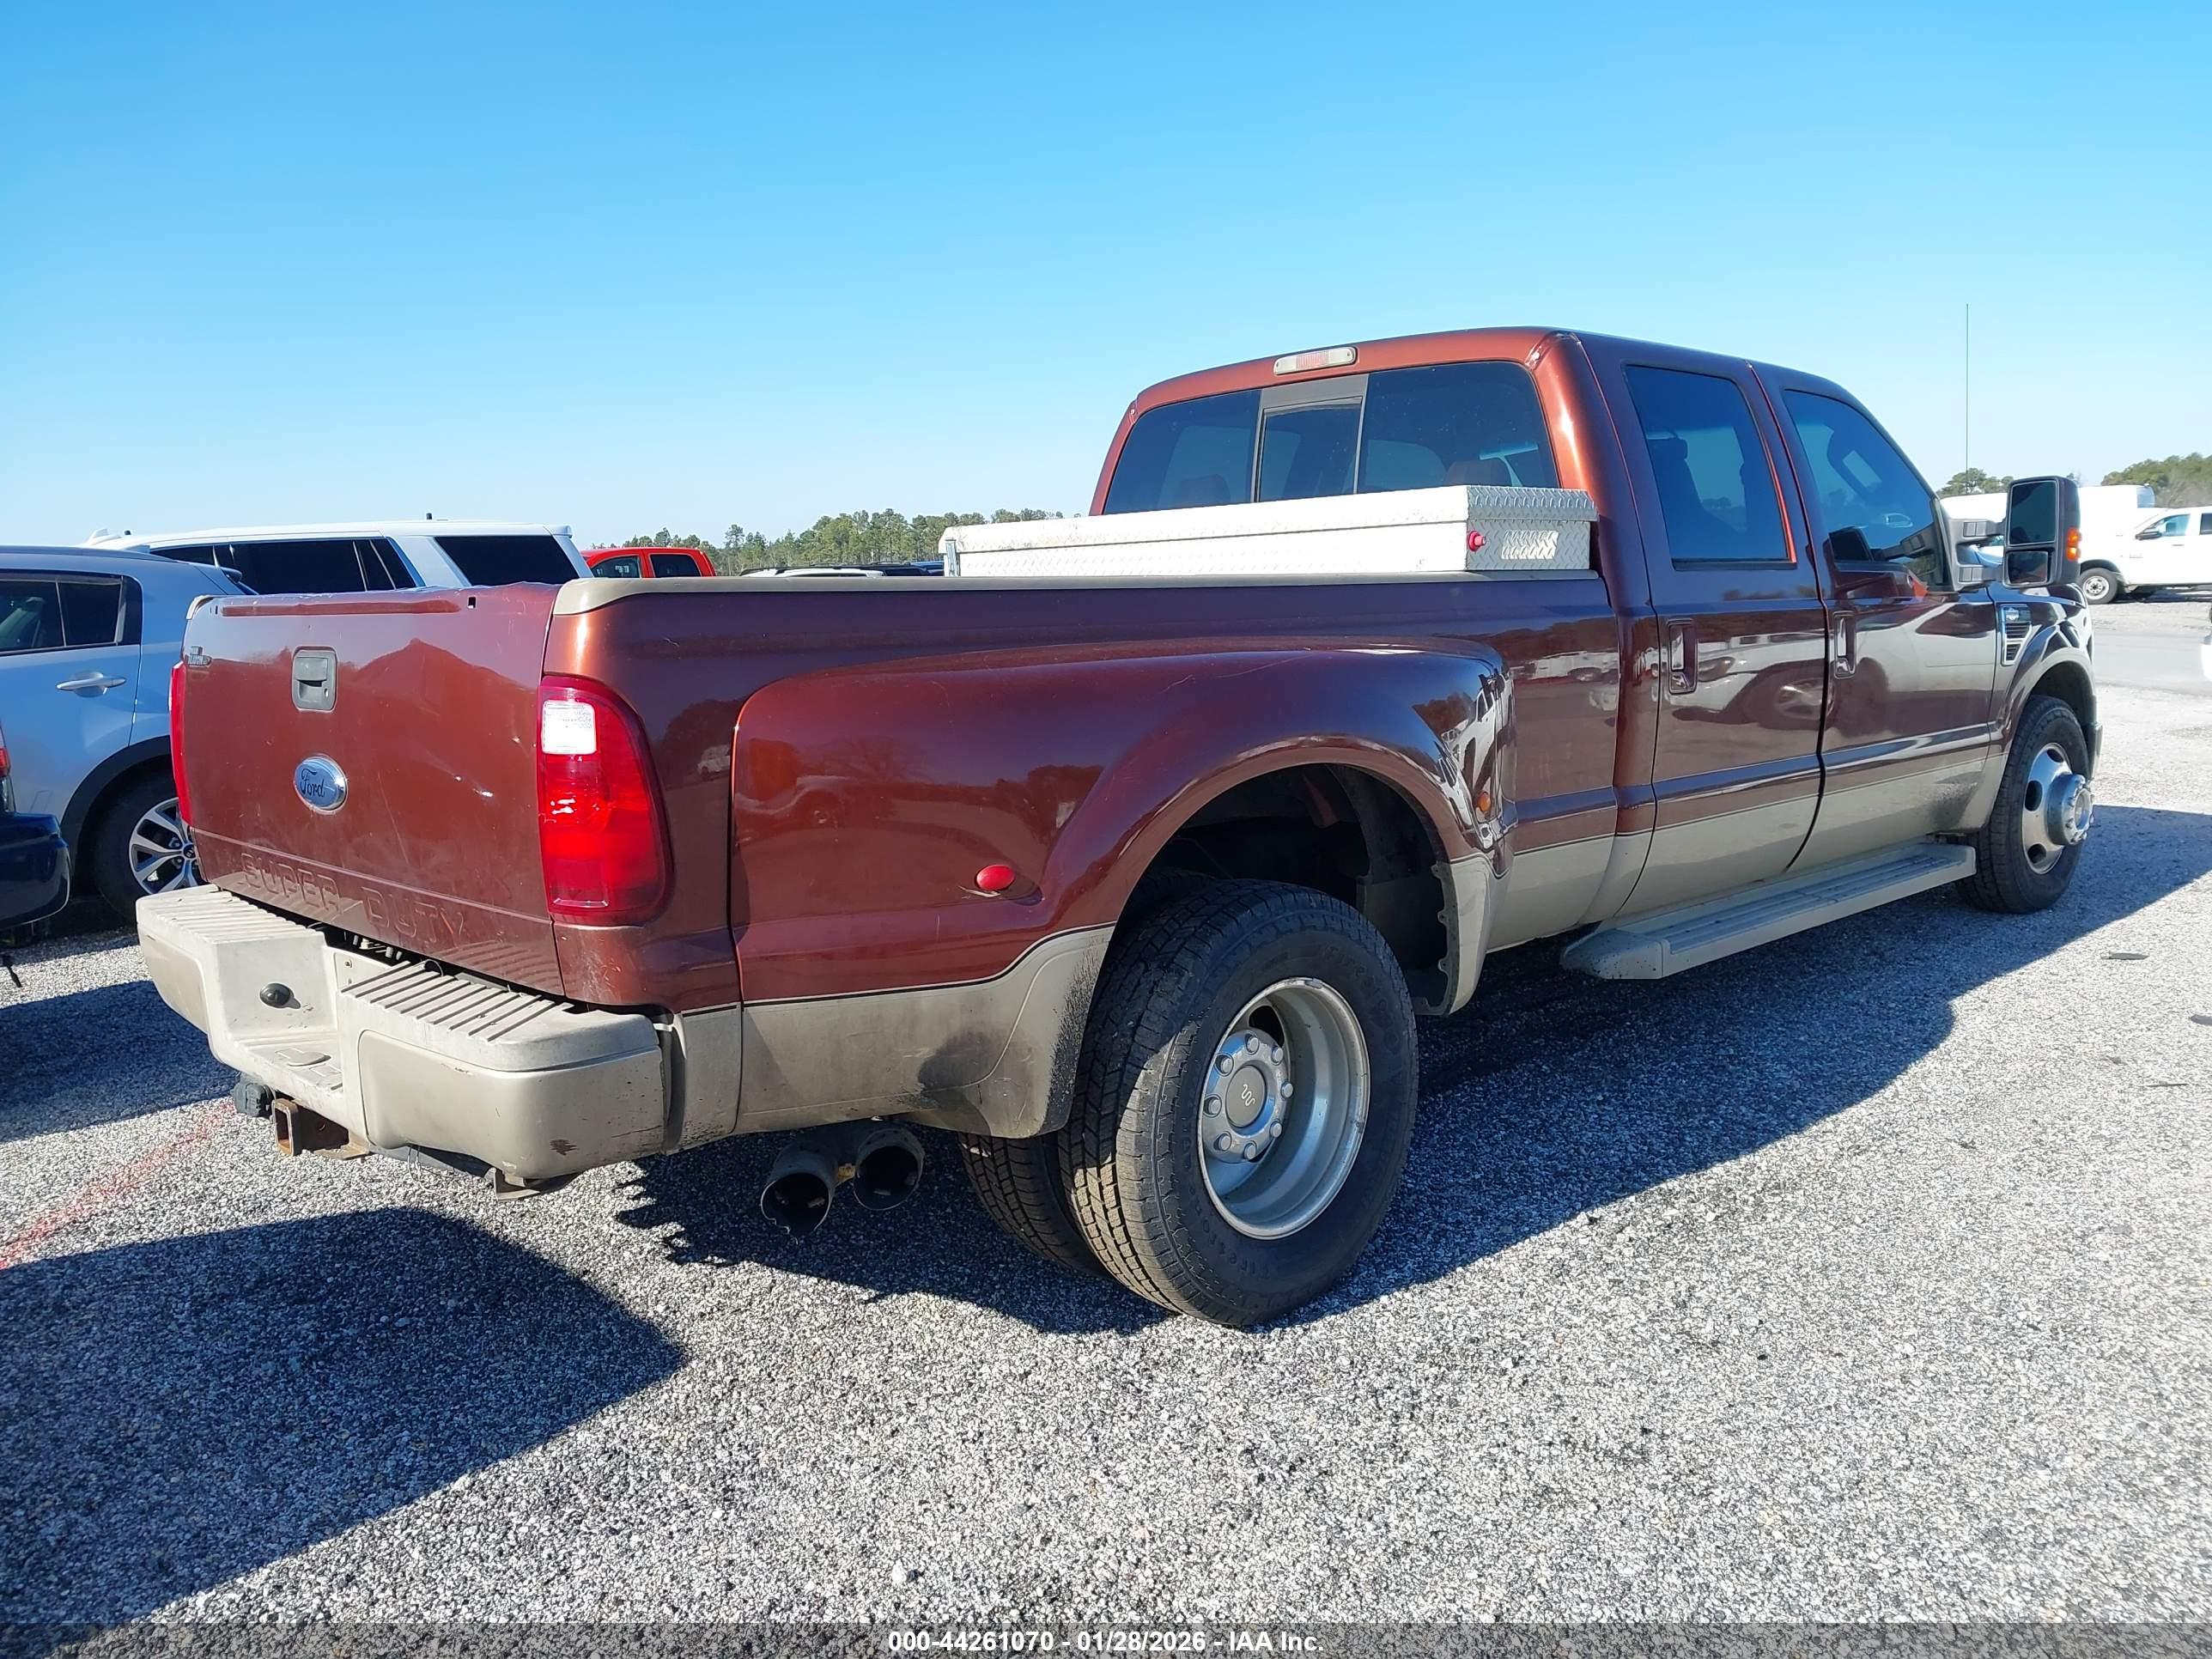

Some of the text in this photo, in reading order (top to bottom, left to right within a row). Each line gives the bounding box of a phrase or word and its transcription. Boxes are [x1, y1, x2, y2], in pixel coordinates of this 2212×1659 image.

[297, 768, 325, 799] Ford
[241, 852, 465, 945] SUPER DUTY
